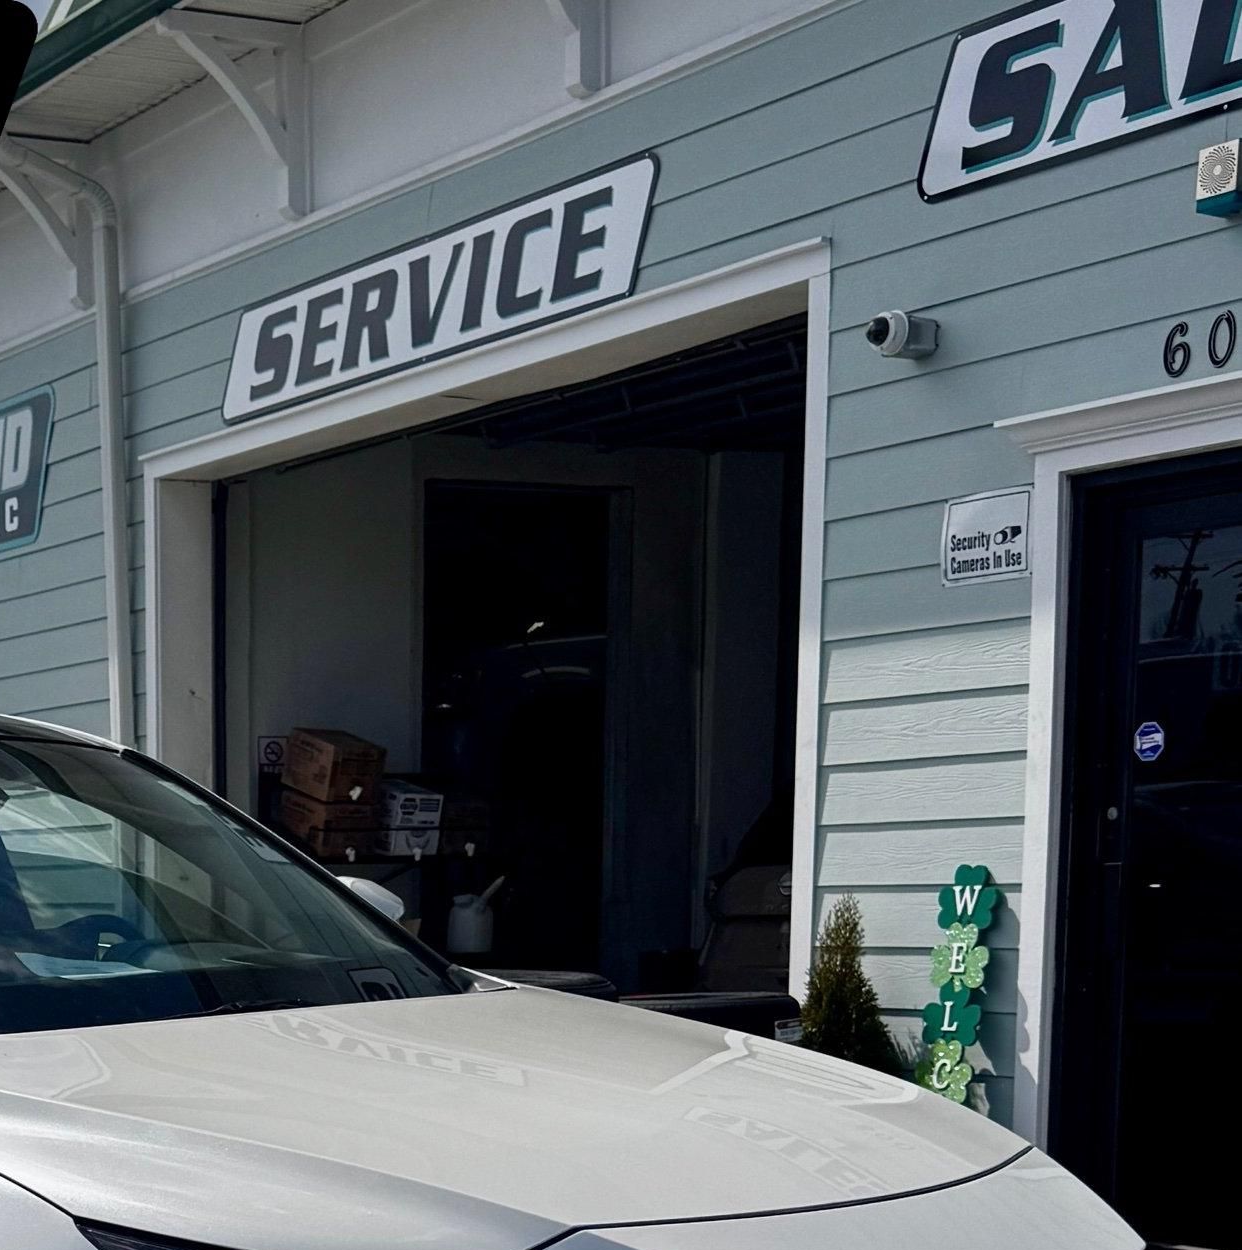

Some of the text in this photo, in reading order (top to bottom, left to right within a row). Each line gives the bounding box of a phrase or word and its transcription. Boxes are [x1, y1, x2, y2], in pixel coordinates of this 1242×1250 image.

[250, 185, 614, 402] SERVICE
[950, 531, 991, 552] Security
[950, 549, 1022, 574] Cameras In Use
